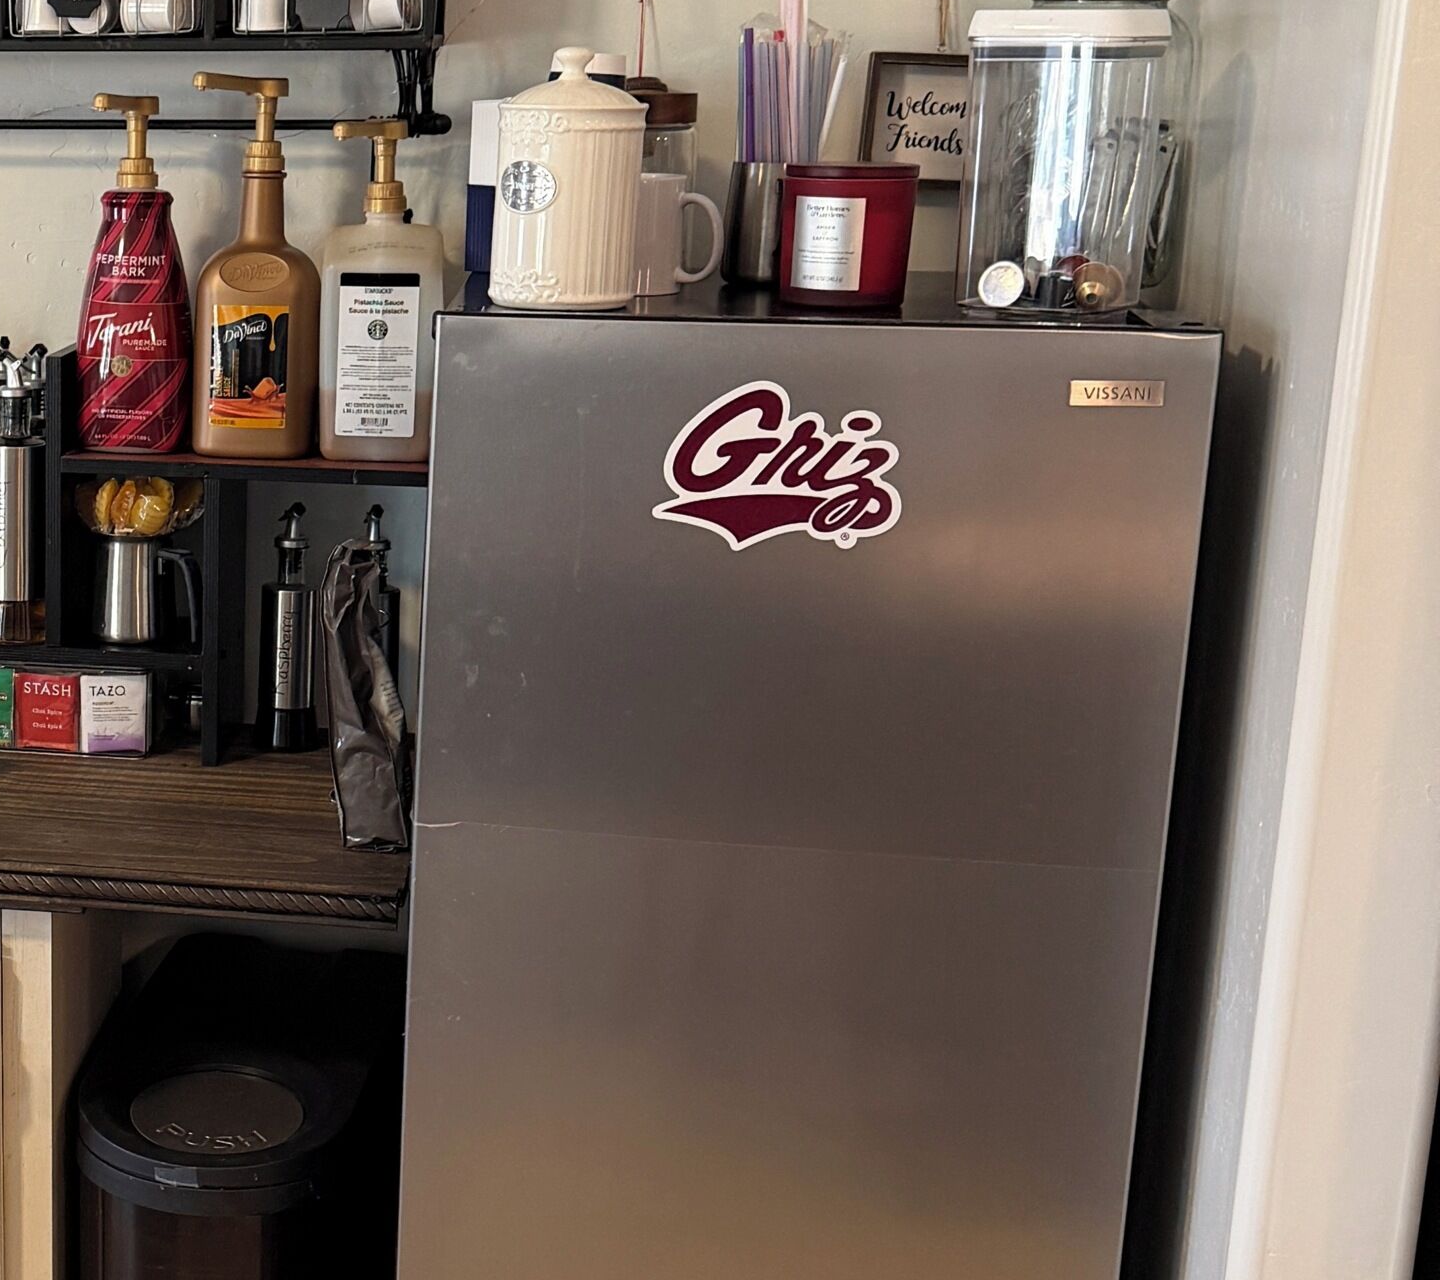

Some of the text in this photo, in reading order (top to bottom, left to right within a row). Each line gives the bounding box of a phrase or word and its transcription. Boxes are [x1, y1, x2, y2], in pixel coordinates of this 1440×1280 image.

[887, 91, 967, 120] Welcom
[886, 123, 963, 155] Friends
[96, 253, 166, 266] PEPPERMINT
[112, 267, 146, 277] BARK
[381, 307, 409, 315] pistache
[122, 338, 167, 346] PUREMADE
[1083, 385, 1153, 402] VISSANI
[667, 384, 897, 535] Griz
[23, 681, 72, 697] STASH
[89, 685, 126, 697] TAZO
[156, 1122, 268, 1152] PUSH
